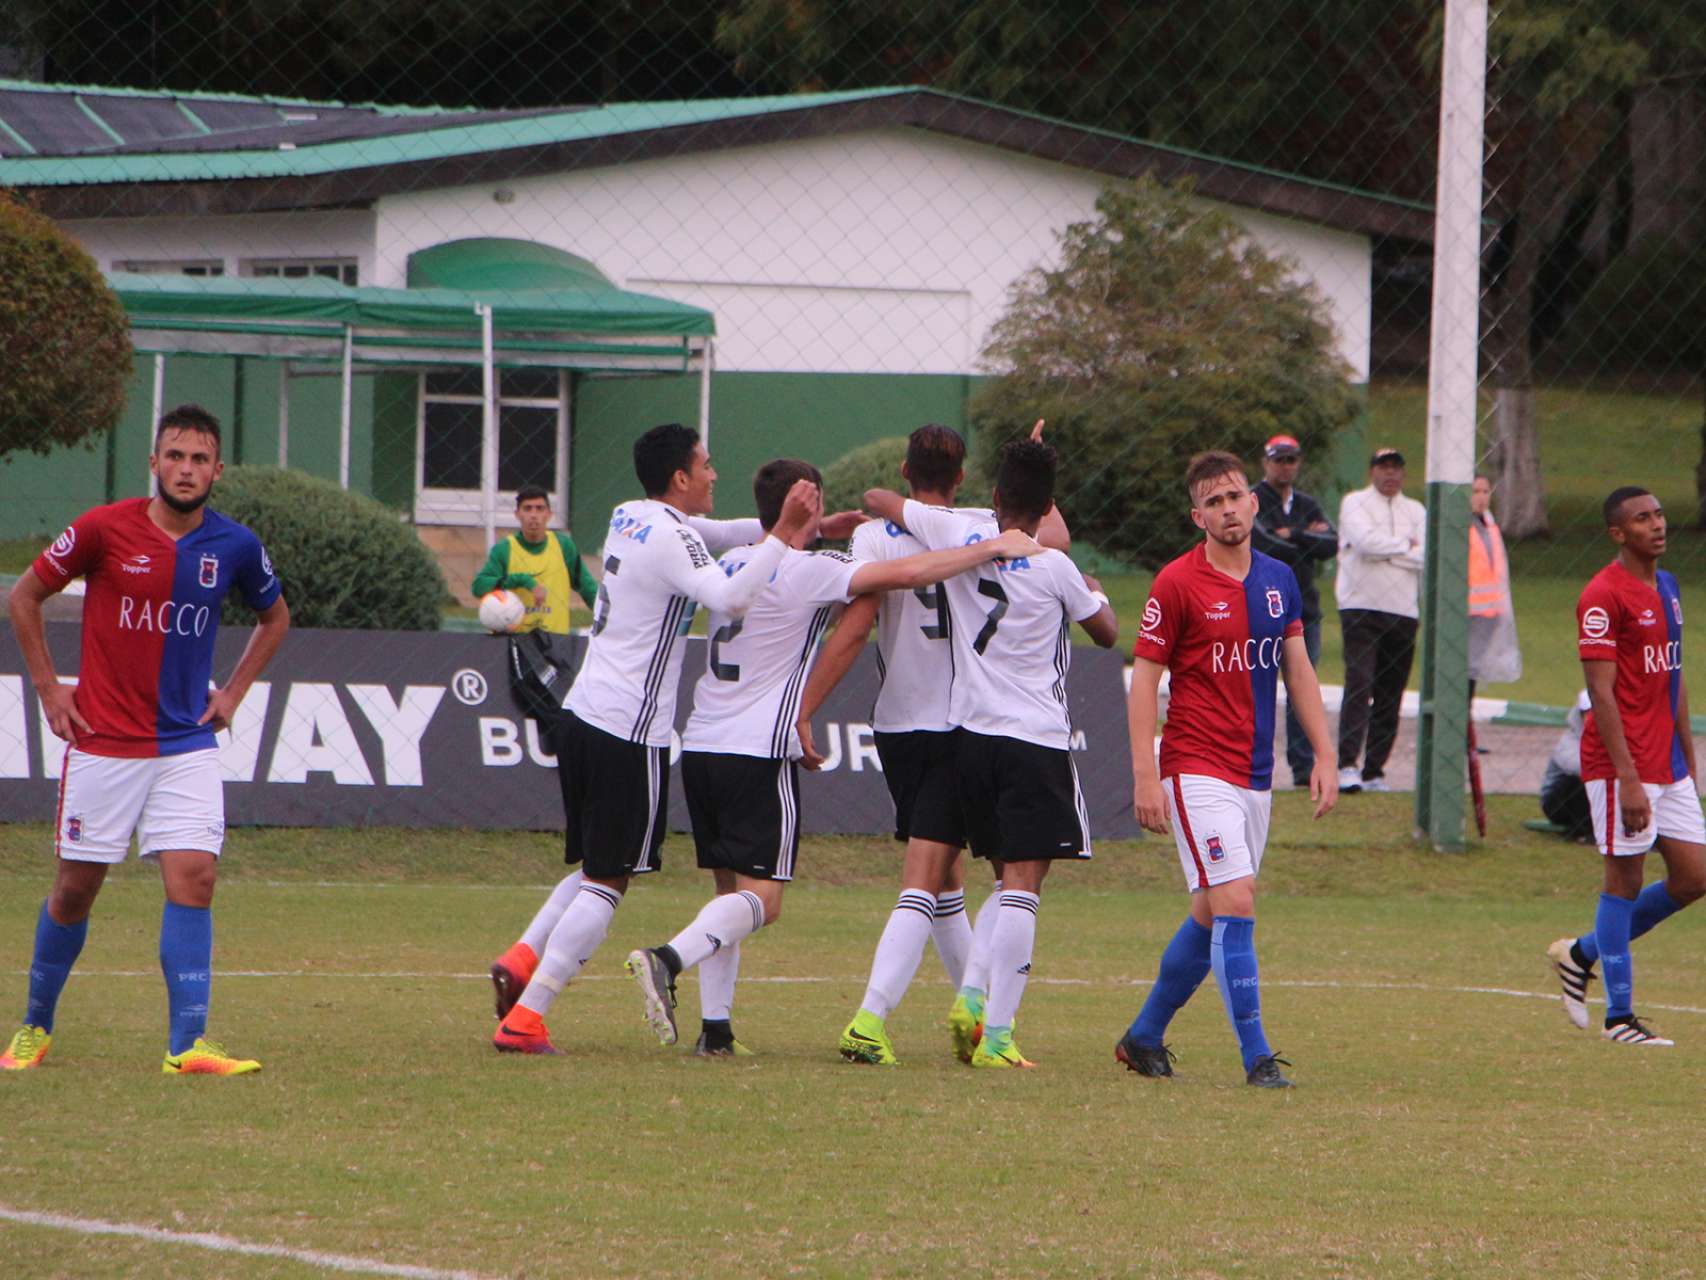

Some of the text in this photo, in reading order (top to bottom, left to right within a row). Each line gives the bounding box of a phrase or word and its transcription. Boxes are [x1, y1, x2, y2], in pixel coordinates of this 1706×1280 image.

[119, 595, 220, 637] RACCO
[973, 577, 1009, 656] 7
[1643, 640, 1681, 674] RACC
[178, 972, 208, 982] PRC
